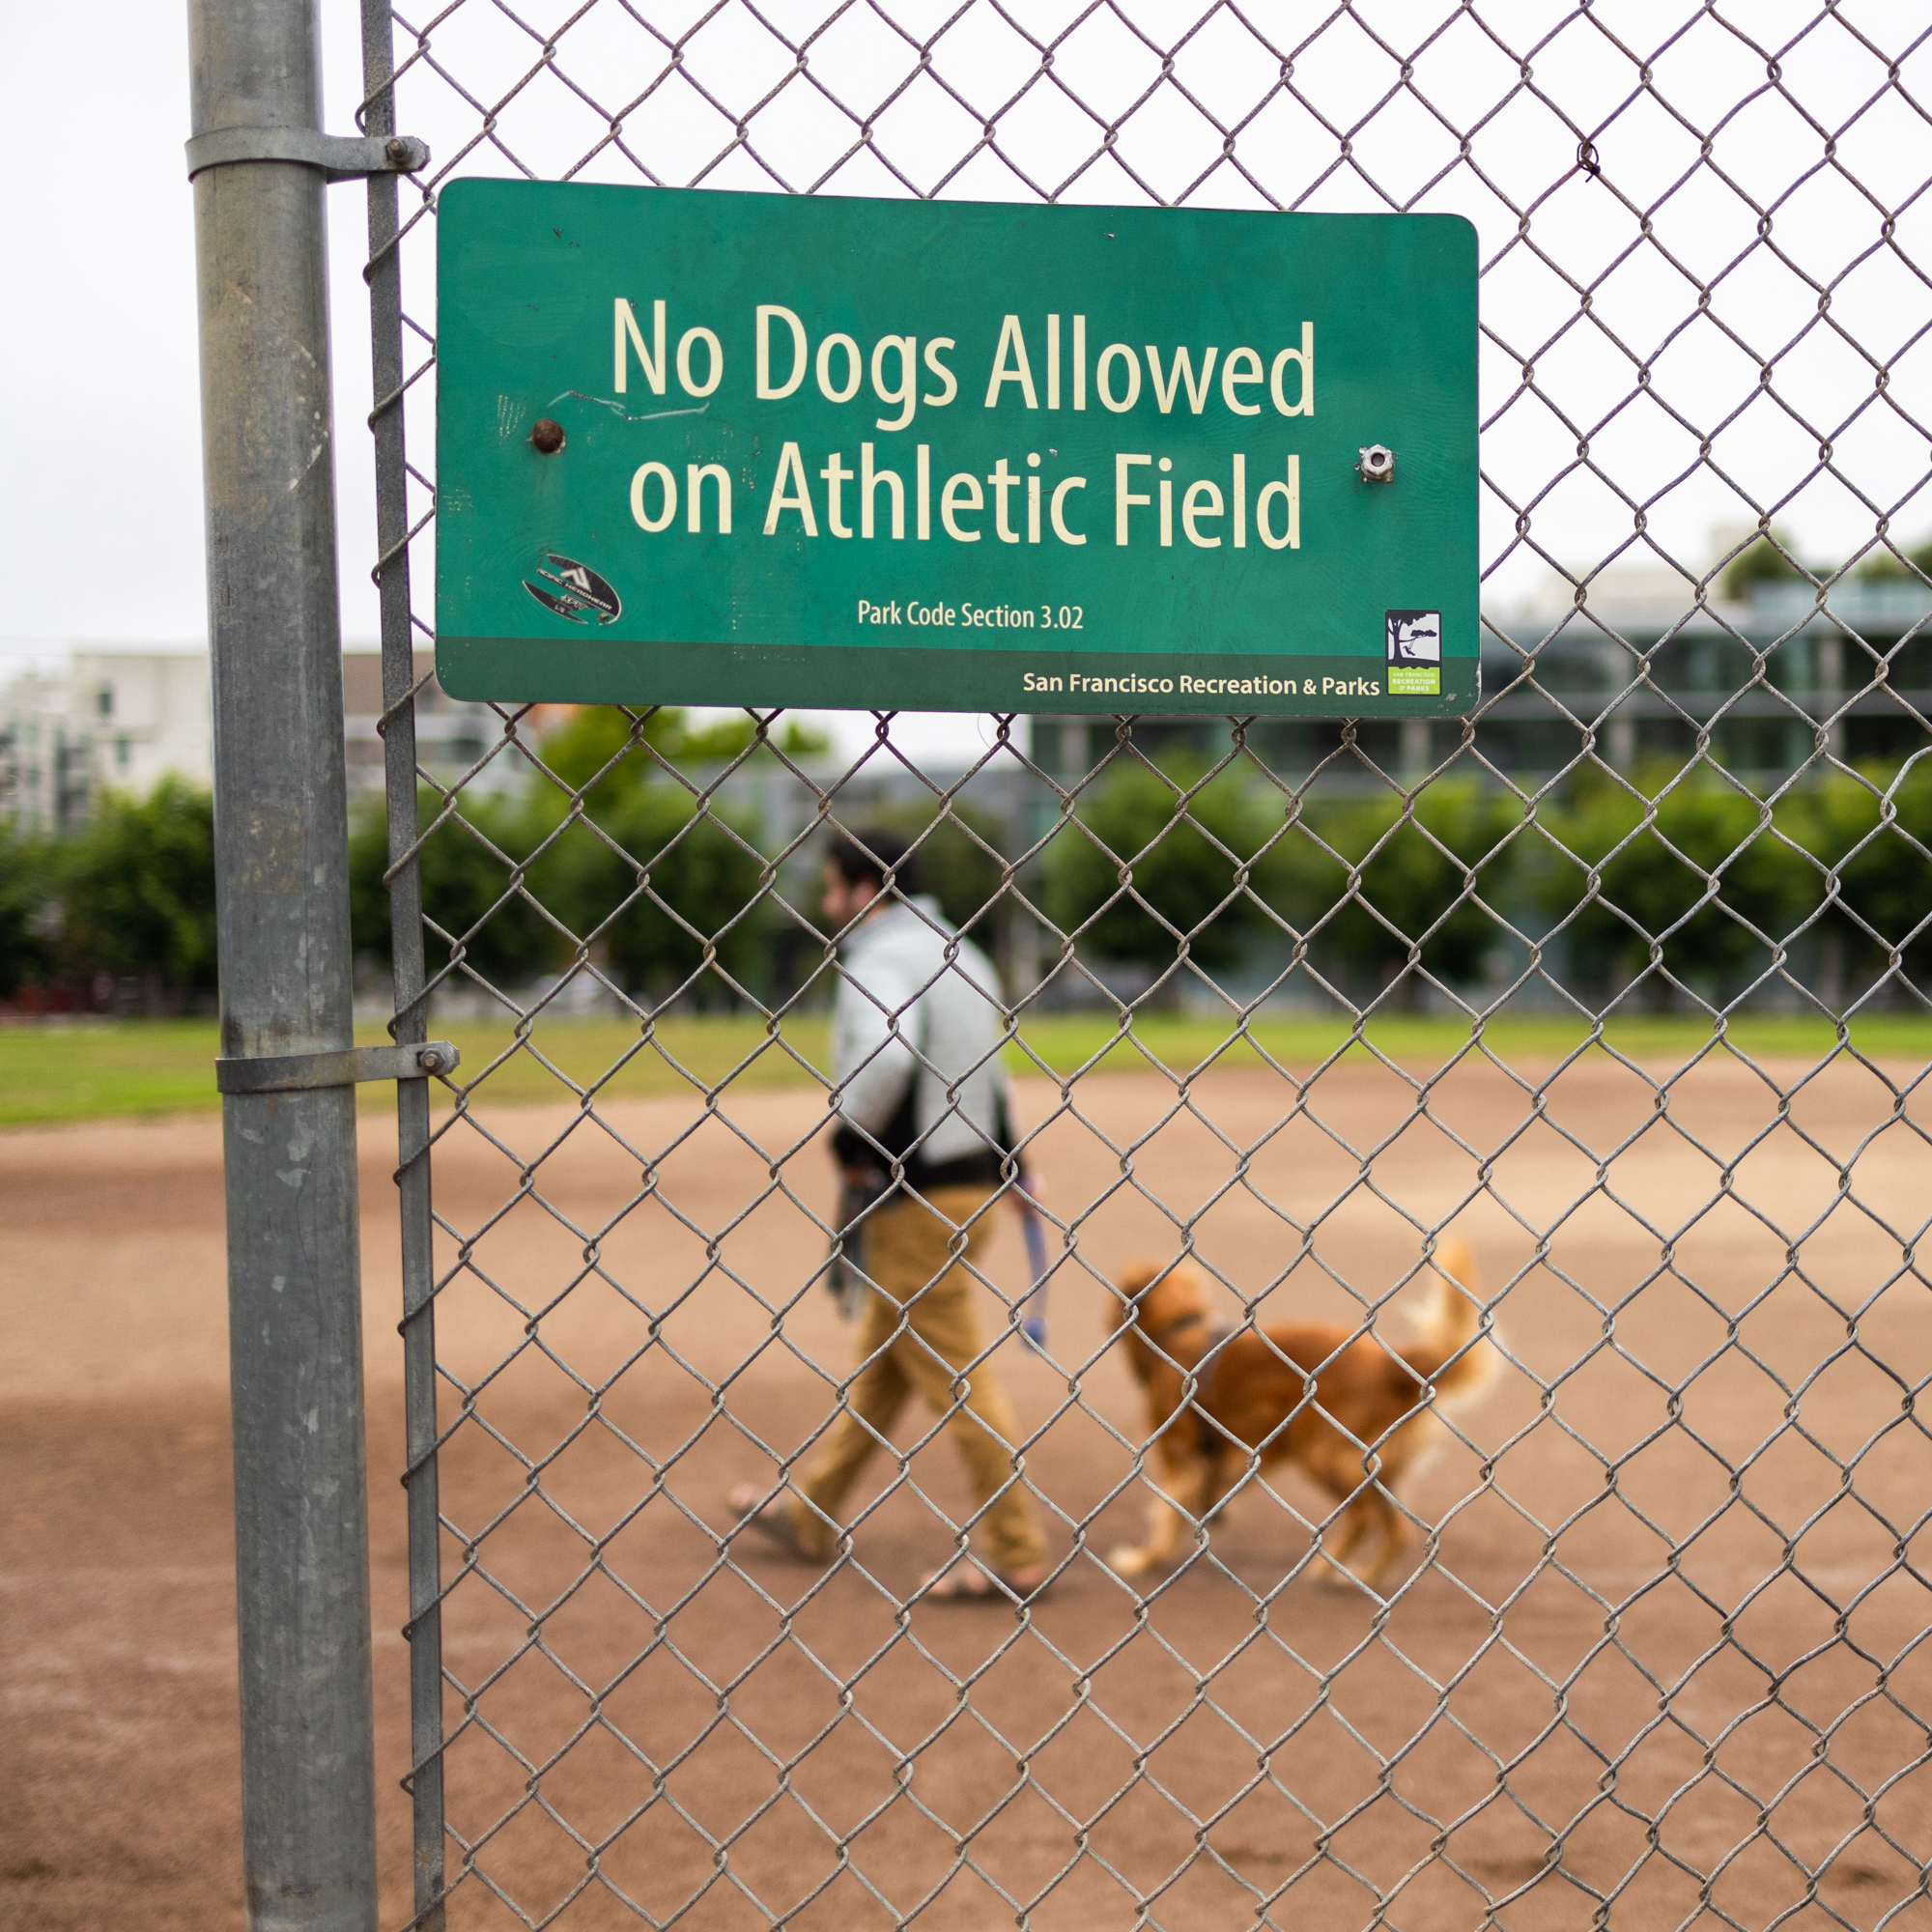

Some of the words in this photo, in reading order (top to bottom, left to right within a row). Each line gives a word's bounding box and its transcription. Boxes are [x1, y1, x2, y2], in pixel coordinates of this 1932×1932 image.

[614, 298, 724, 398] No
[755, 304, 958, 433] Dogs
[984, 314, 1316, 417] Allowed
[630, 461, 732, 534] on
[762, 441, 1087, 546] Athletic
[1115, 453, 1301, 551] Field
[537, 568, 563, 585] ACIFIC
[858, 599, 902, 625] Park
[906, 601, 955, 627] Code
[961, 602, 1035, 628] Section
[1040, 605, 1084, 630] 3.02
[1023, 672, 1064, 692] San
[1069, 672, 1175, 695] Francisco
[1179, 674, 1297, 696] Recreation
[1302, 678, 1318, 696] &
[1321, 676, 1380, 696] Parks
